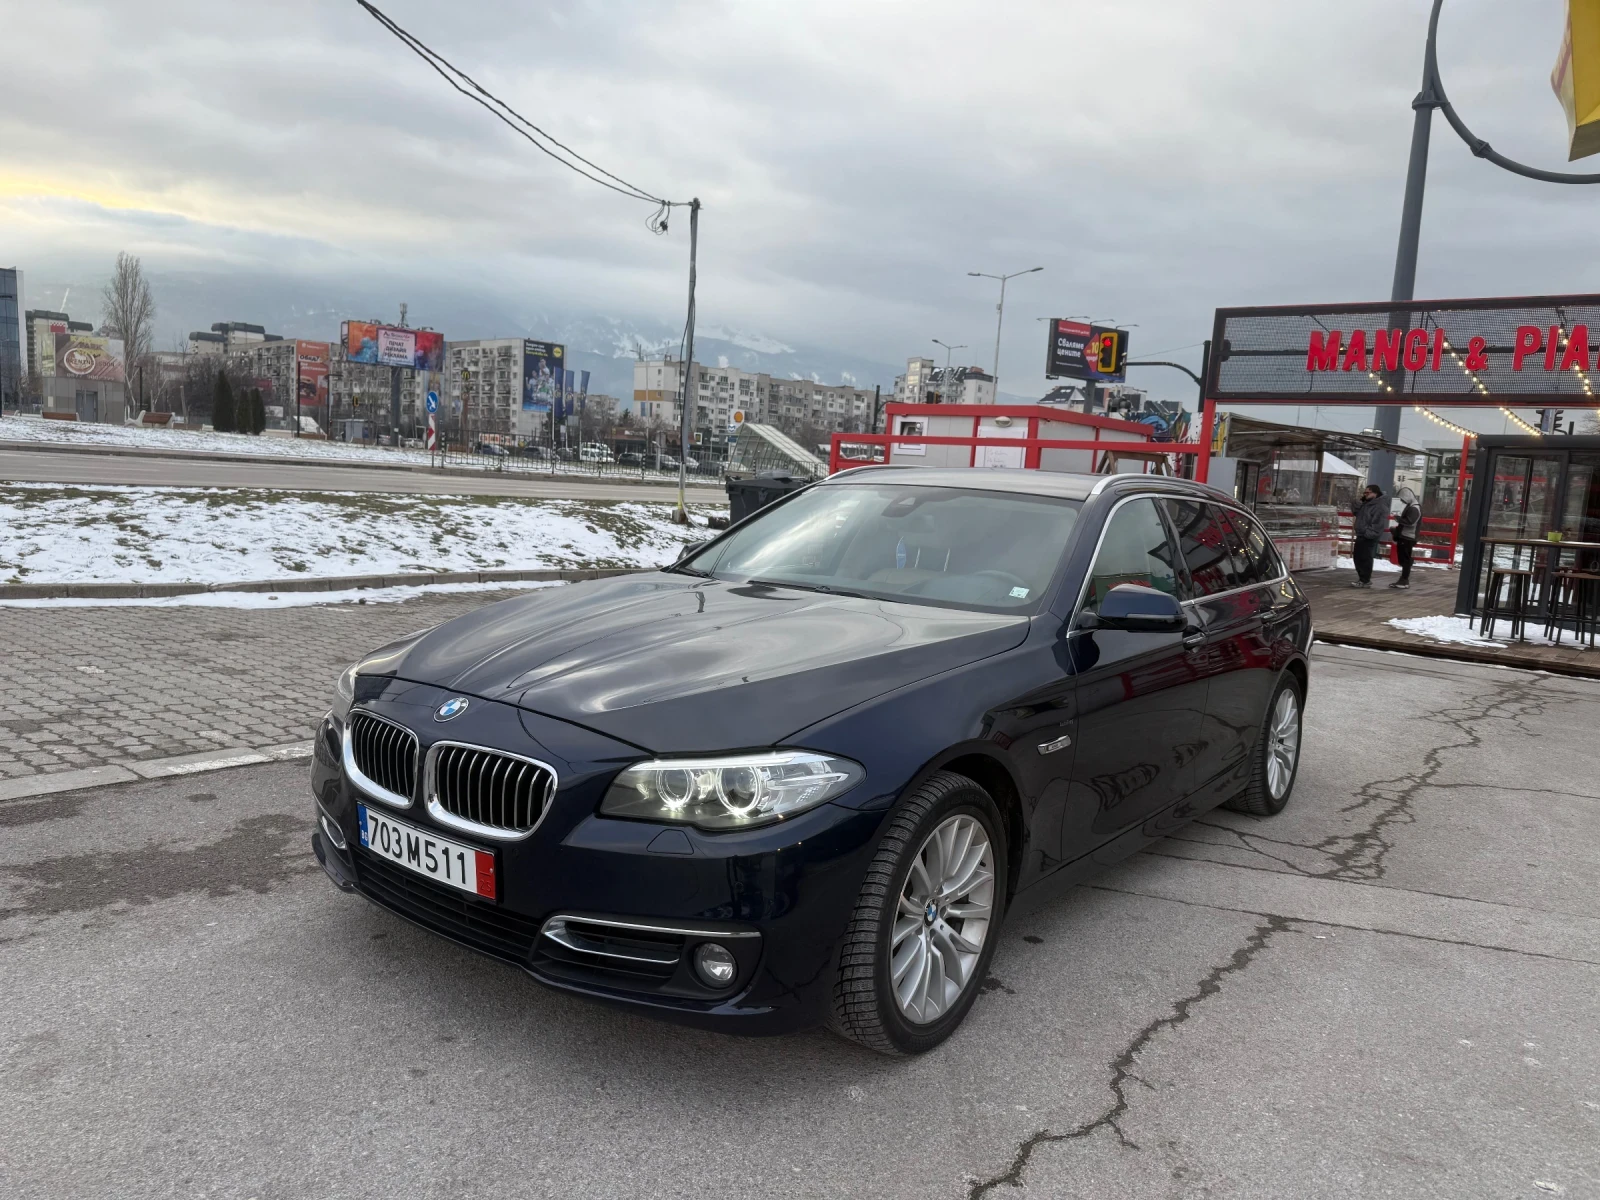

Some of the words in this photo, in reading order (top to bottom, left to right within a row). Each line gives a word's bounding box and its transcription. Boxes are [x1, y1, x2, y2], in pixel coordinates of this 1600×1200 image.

[1057, 337, 1085, 350] Сваляме
[1306, 327, 1445, 371] MANGI
[1465, 336, 1489, 371] &
[1512, 324, 1600, 371] PIA
[384, 351, 409, 360] РЕКЛАМА
[1056, 347, 1082, 358] цените
[361, 829, 368, 842] BG
[368, 814, 467, 885] 703M511
